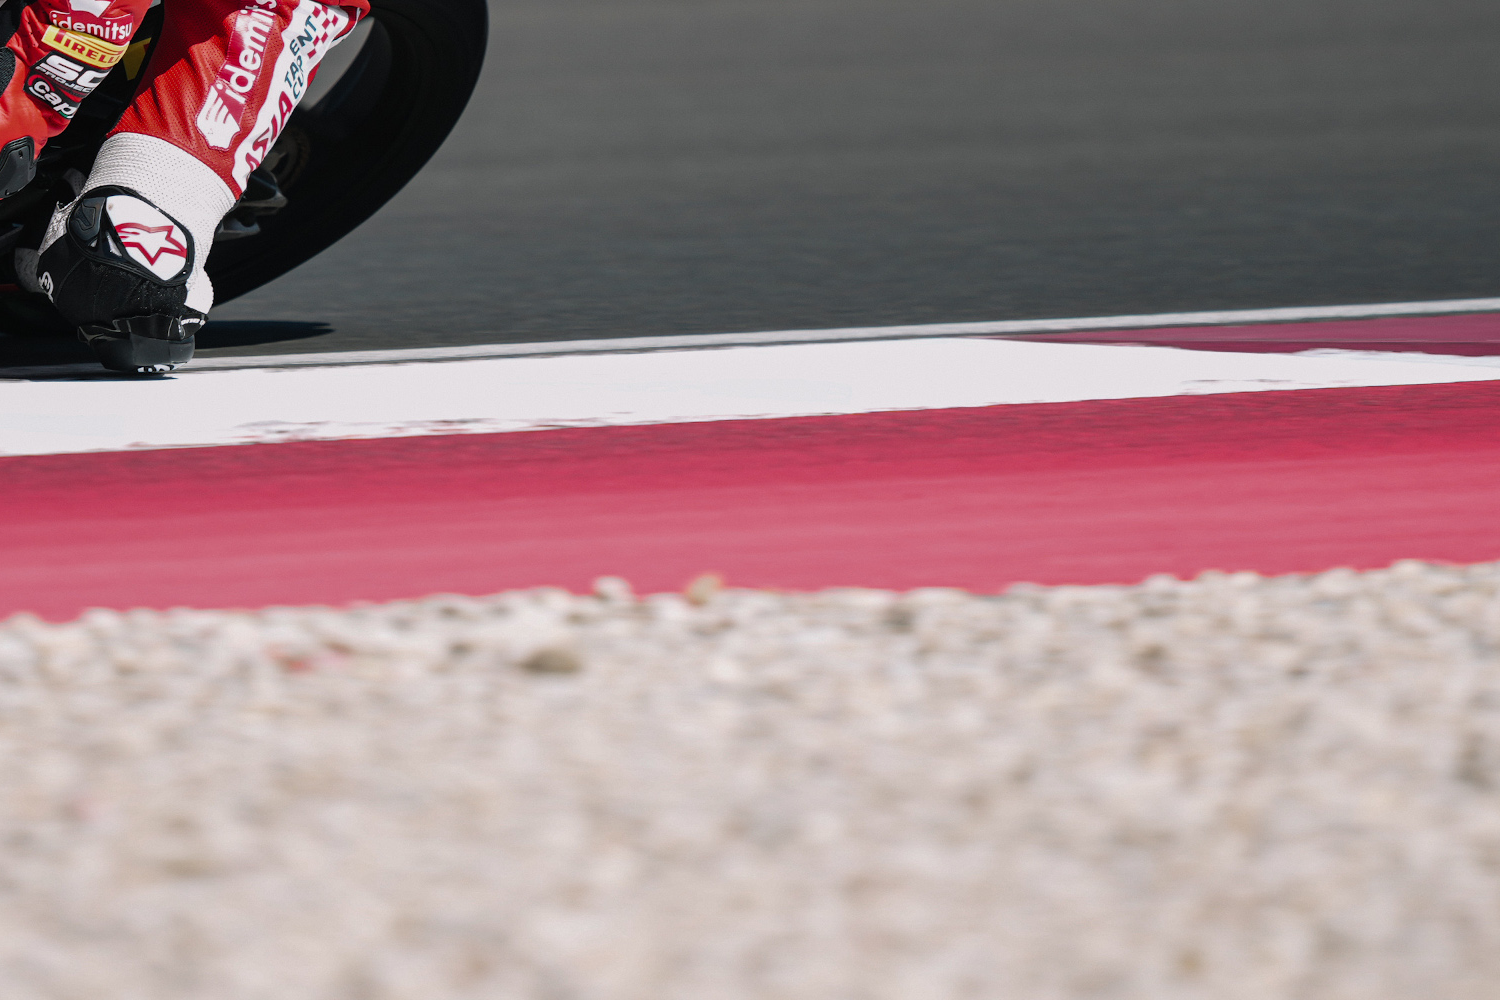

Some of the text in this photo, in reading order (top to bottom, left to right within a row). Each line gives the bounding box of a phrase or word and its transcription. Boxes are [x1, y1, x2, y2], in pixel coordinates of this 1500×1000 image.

[51, 13, 133, 41] idemitsu
[284, 15, 318, 89] TAENT
[35, 66, 95, 93] PROJEC
